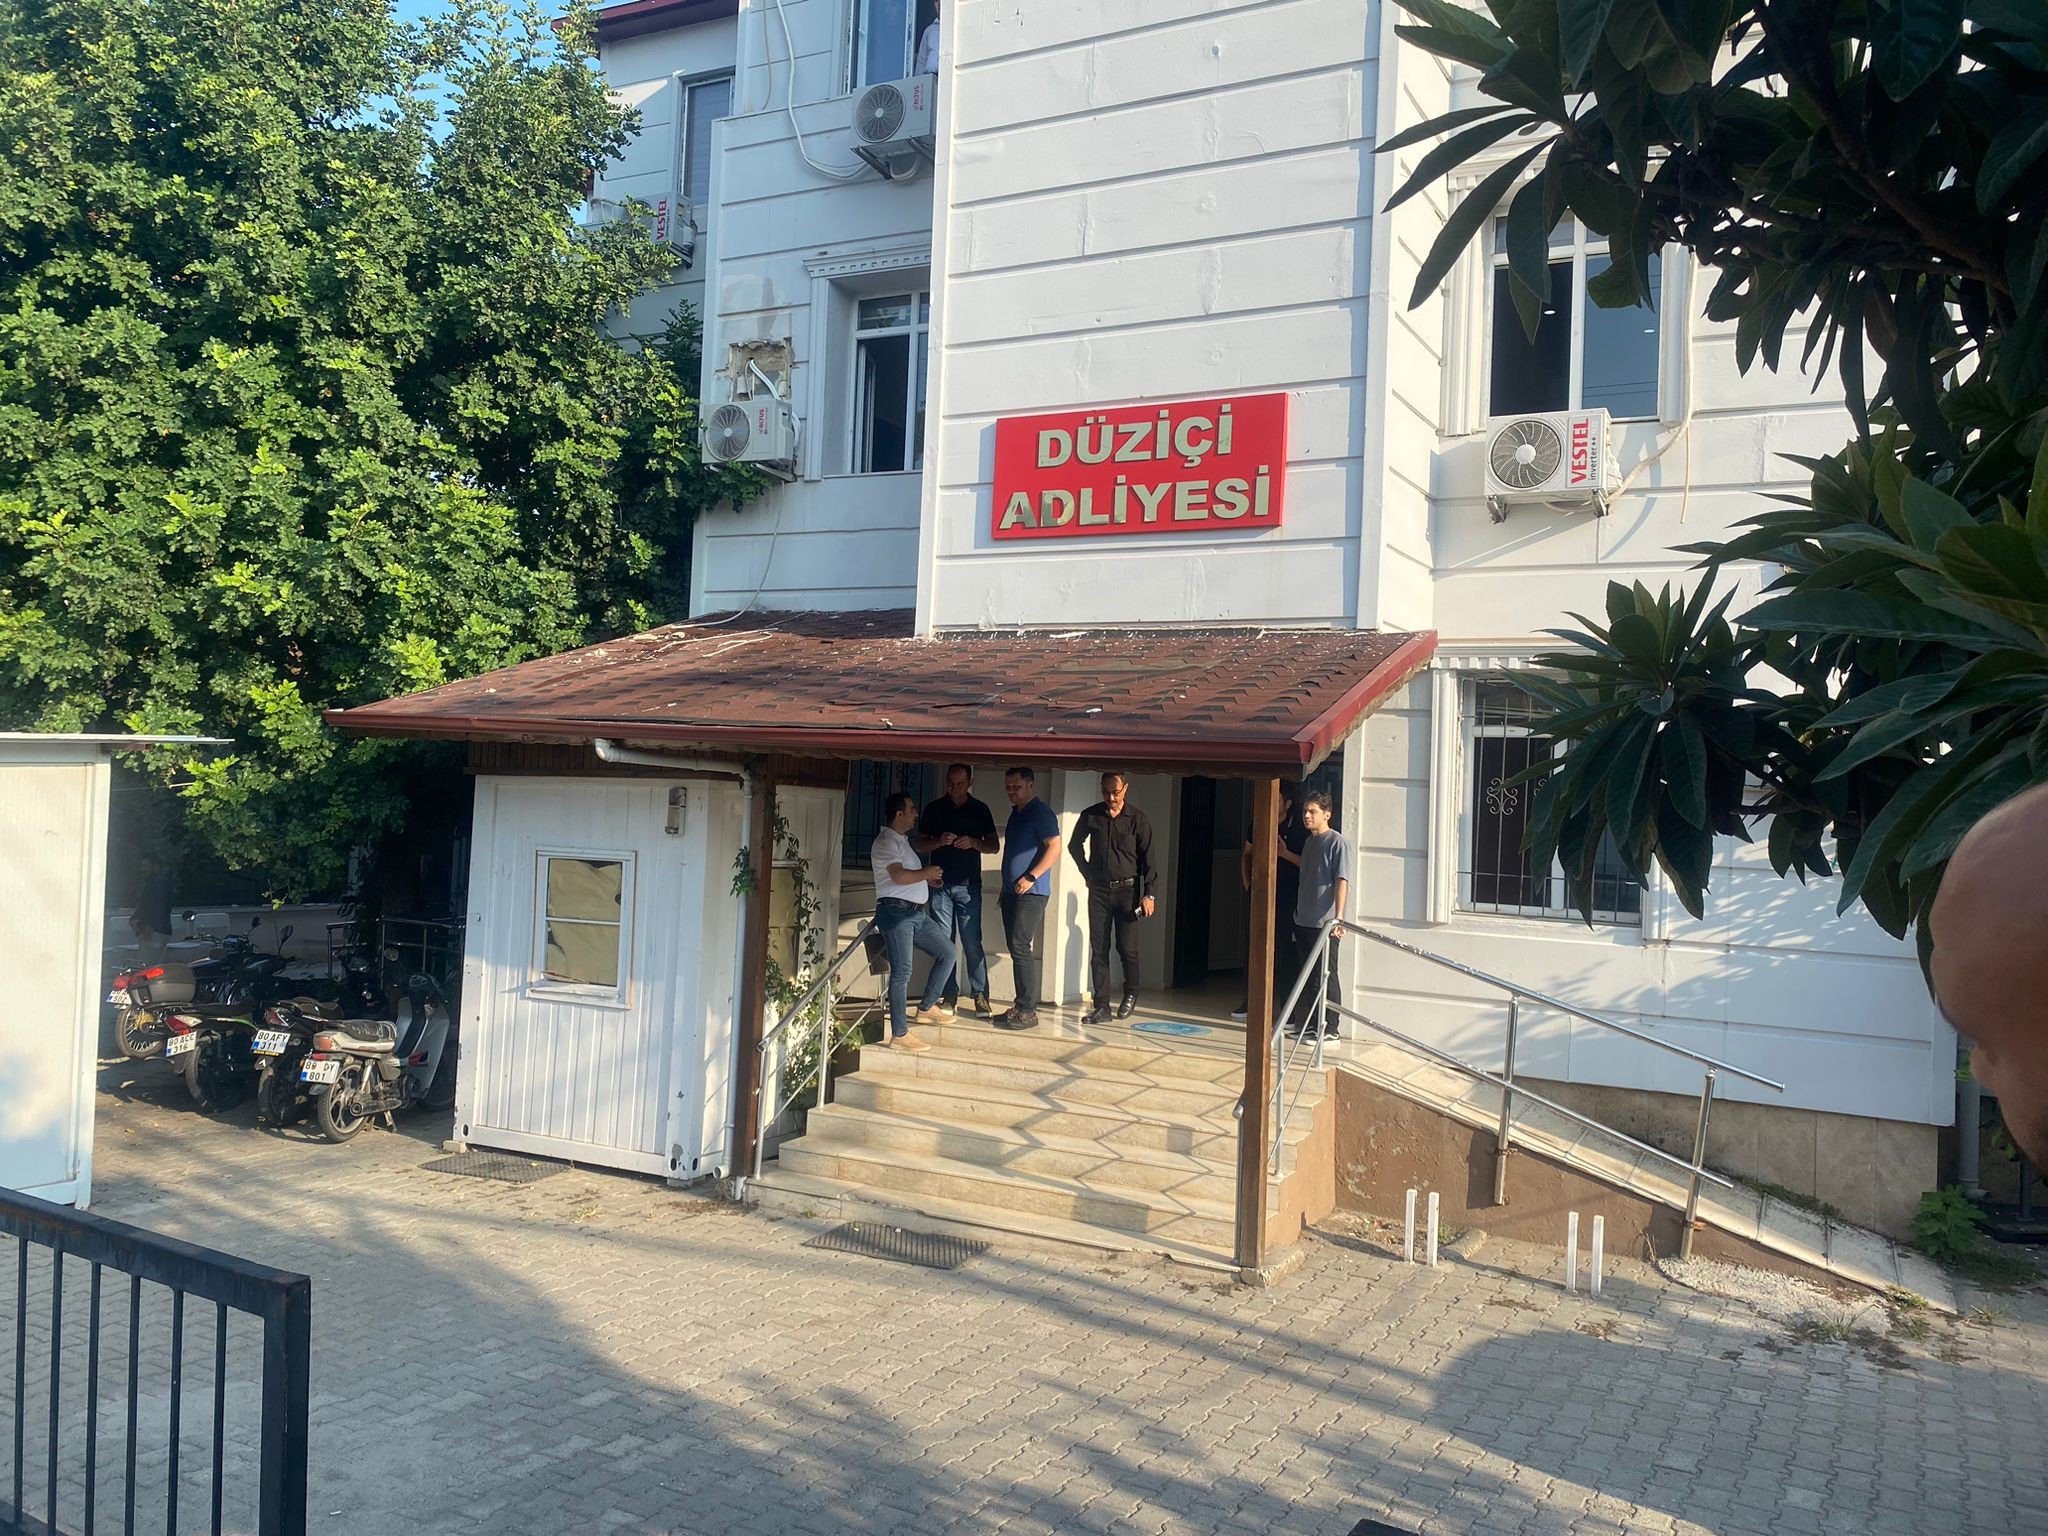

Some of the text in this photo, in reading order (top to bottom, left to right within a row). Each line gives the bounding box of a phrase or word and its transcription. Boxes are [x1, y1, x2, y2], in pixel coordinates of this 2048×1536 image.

[657, 197, 668, 241] VESTEL
[1037, 403, 1233, 468] DÜZİÇİ
[1571, 418, 1589, 484] VESTEL
[998, 464, 1271, 530] ADLİYESİ
[260, 1041, 277, 1050] 311
[270, 1033, 288, 1042] AFY
[309, 1071, 325, 1081] 801
